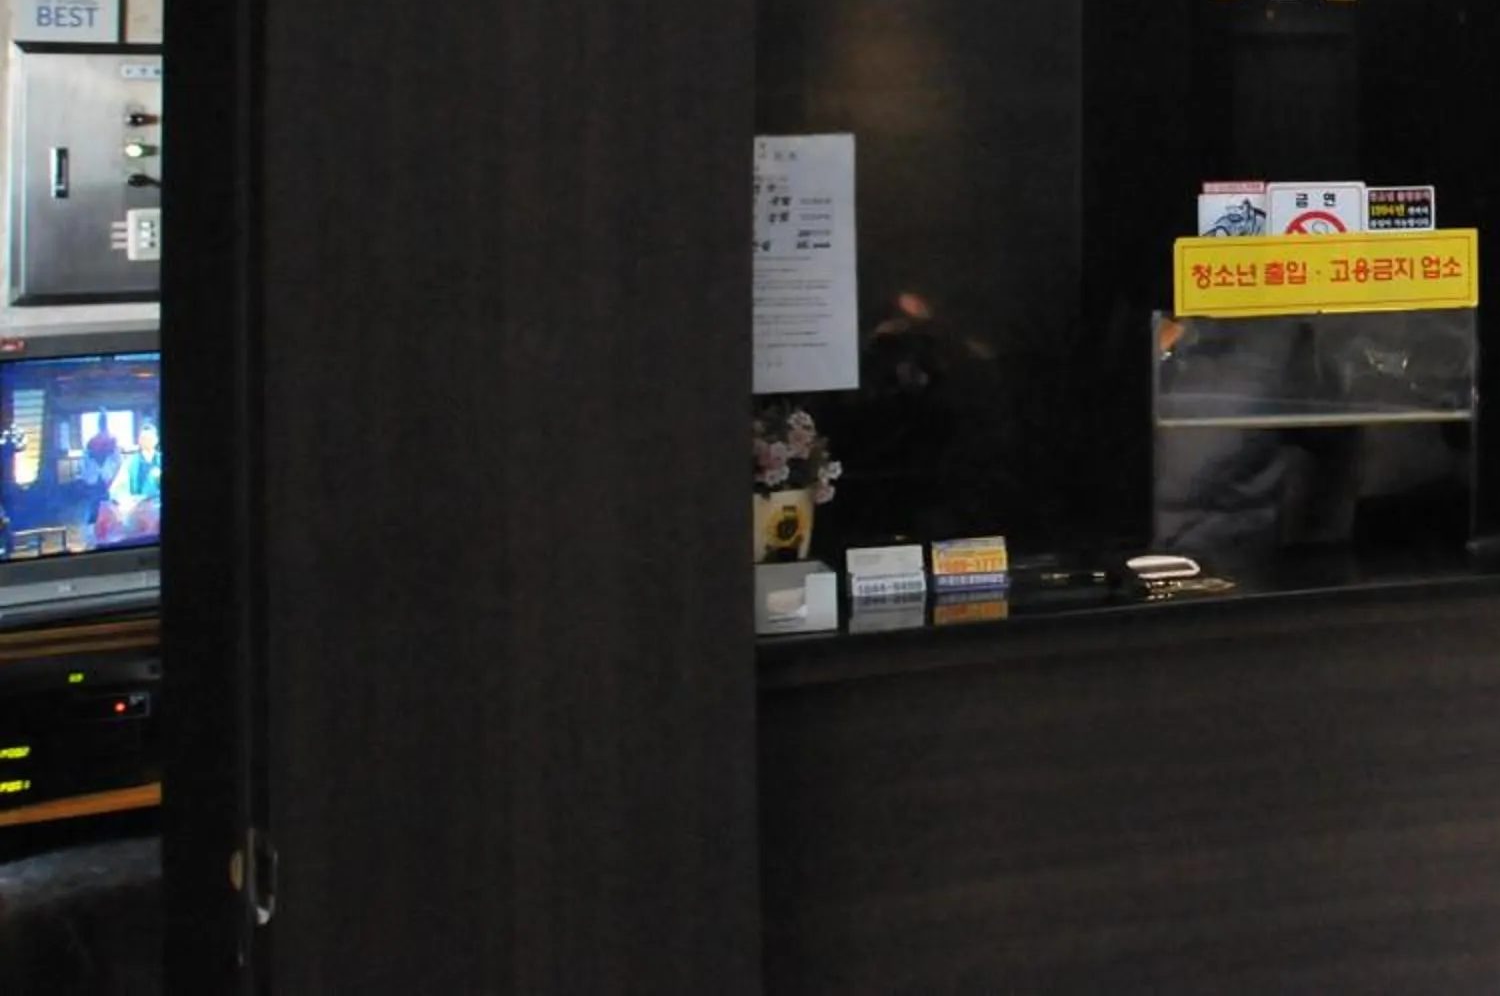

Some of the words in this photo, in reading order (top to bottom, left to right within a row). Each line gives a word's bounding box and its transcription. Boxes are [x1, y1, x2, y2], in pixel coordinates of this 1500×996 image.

[37, 6, 99, 27] BEST
[1191, 263, 1257, 289] 청소년
[1264, 261, 1307, 286] 출입
[1330, 257, 1414, 283] 고용금지
[1421, 255, 1462, 279] 업소
